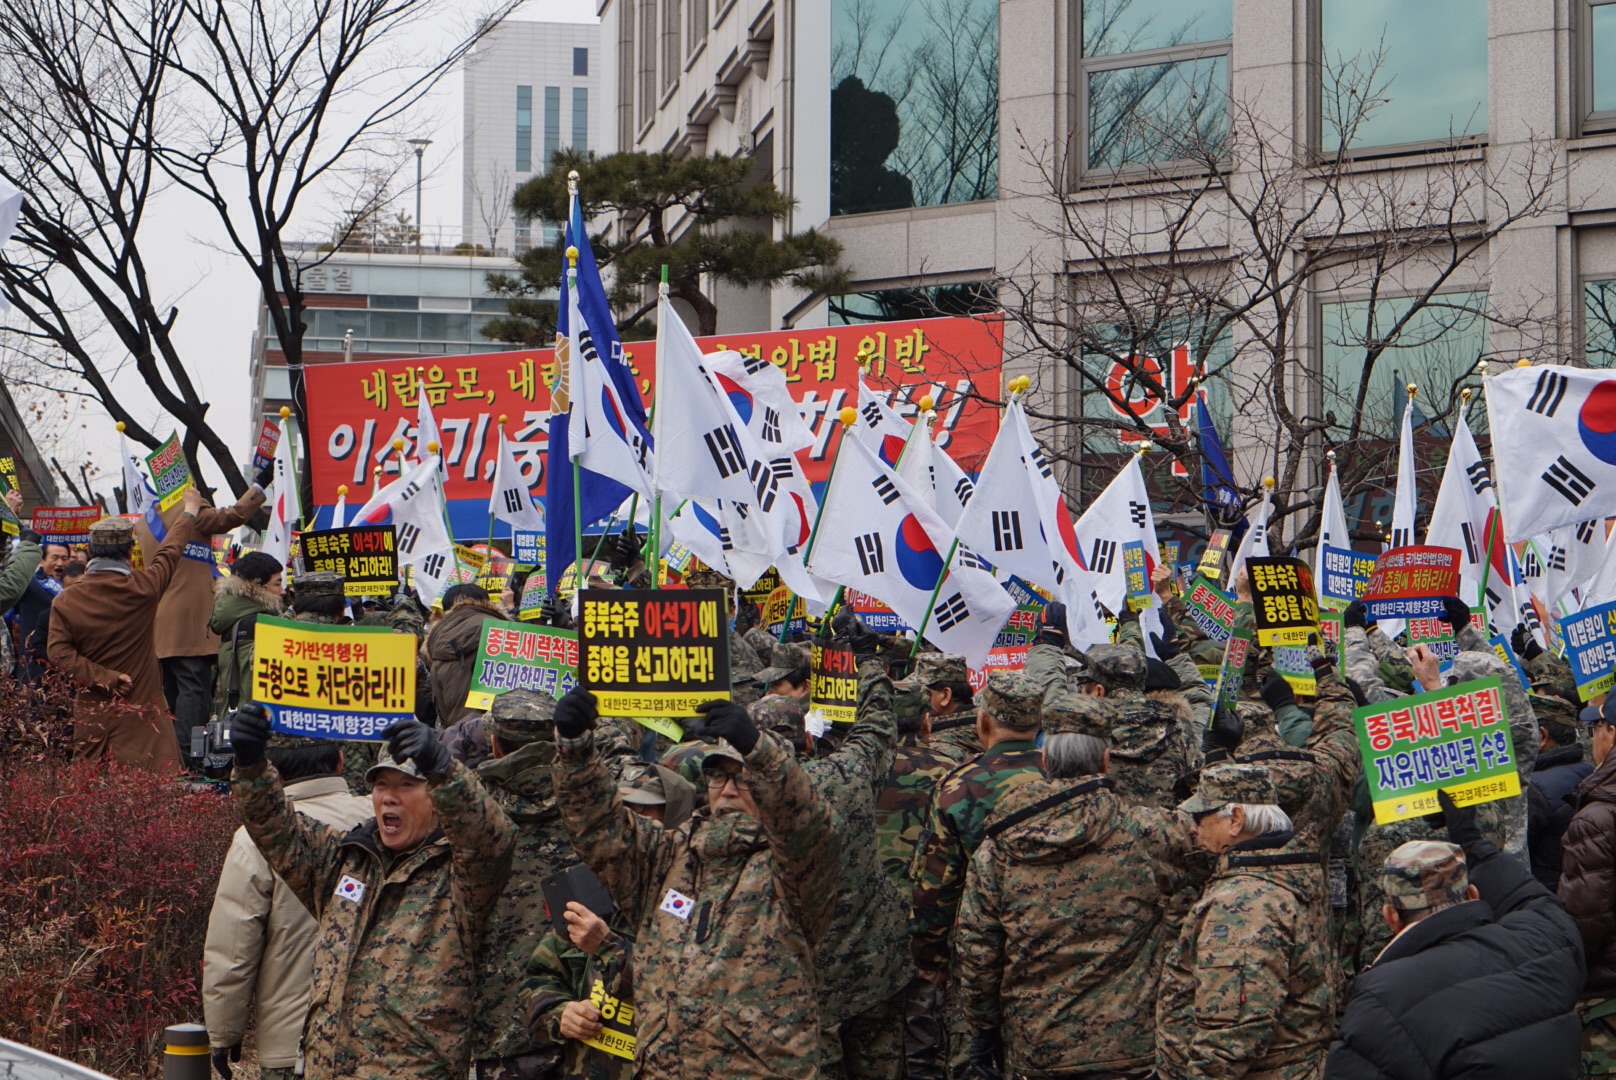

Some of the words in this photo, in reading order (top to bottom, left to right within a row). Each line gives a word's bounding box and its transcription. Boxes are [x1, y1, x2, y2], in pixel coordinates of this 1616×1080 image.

[361, 364, 496, 411] 내란음모,
[854, 328, 931, 376] 위반
[306, 533, 350, 557] 종북숙주
[352, 531, 394, 552] 이석기에
[349, 556, 393, 578] 선고하라!
[1326, 552, 1351, 575] 대법원의
[1252, 565, 1299, 592] 종북숙주
[1328, 574, 1353, 596] 대한민국
[1411, 568, 1453, 592] 처하라!!
[1190, 582, 1237, 628] 종북세력
[1263, 595, 1302, 623] 중형을
[584, 601, 640, 639] 종북숙주
[644, 601, 718, 639] 이석기에
[865, 615, 910, 627] 대한민국재
[1566, 613, 1607, 648] 대법원의
[1283, 631, 1307, 641] 대한민
[282, 638, 368, 664] 국가반역행위
[587, 646, 630, 683] 중형을
[634, 645, 714, 684] 선고하라!
[823, 647, 858, 674] 이석기
[1578, 640, 1616, 676] 대한민국
[257, 658, 310, 700] 극형으로
[316, 664, 406, 708] 처단하라!!
[479, 659, 558, 696] 자유대한민국
[560, 671, 579, 696] 수
[279, 709, 405, 735] 대한민국재향경우
[1365, 687, 1503, 752] 종북세력척결!
[1374, 737, 1480, 790] 자유대한민국
[1481, 730, 1510, 771] 수호
[1413, 781, 1508, 811] 대한국고엽제전우회
